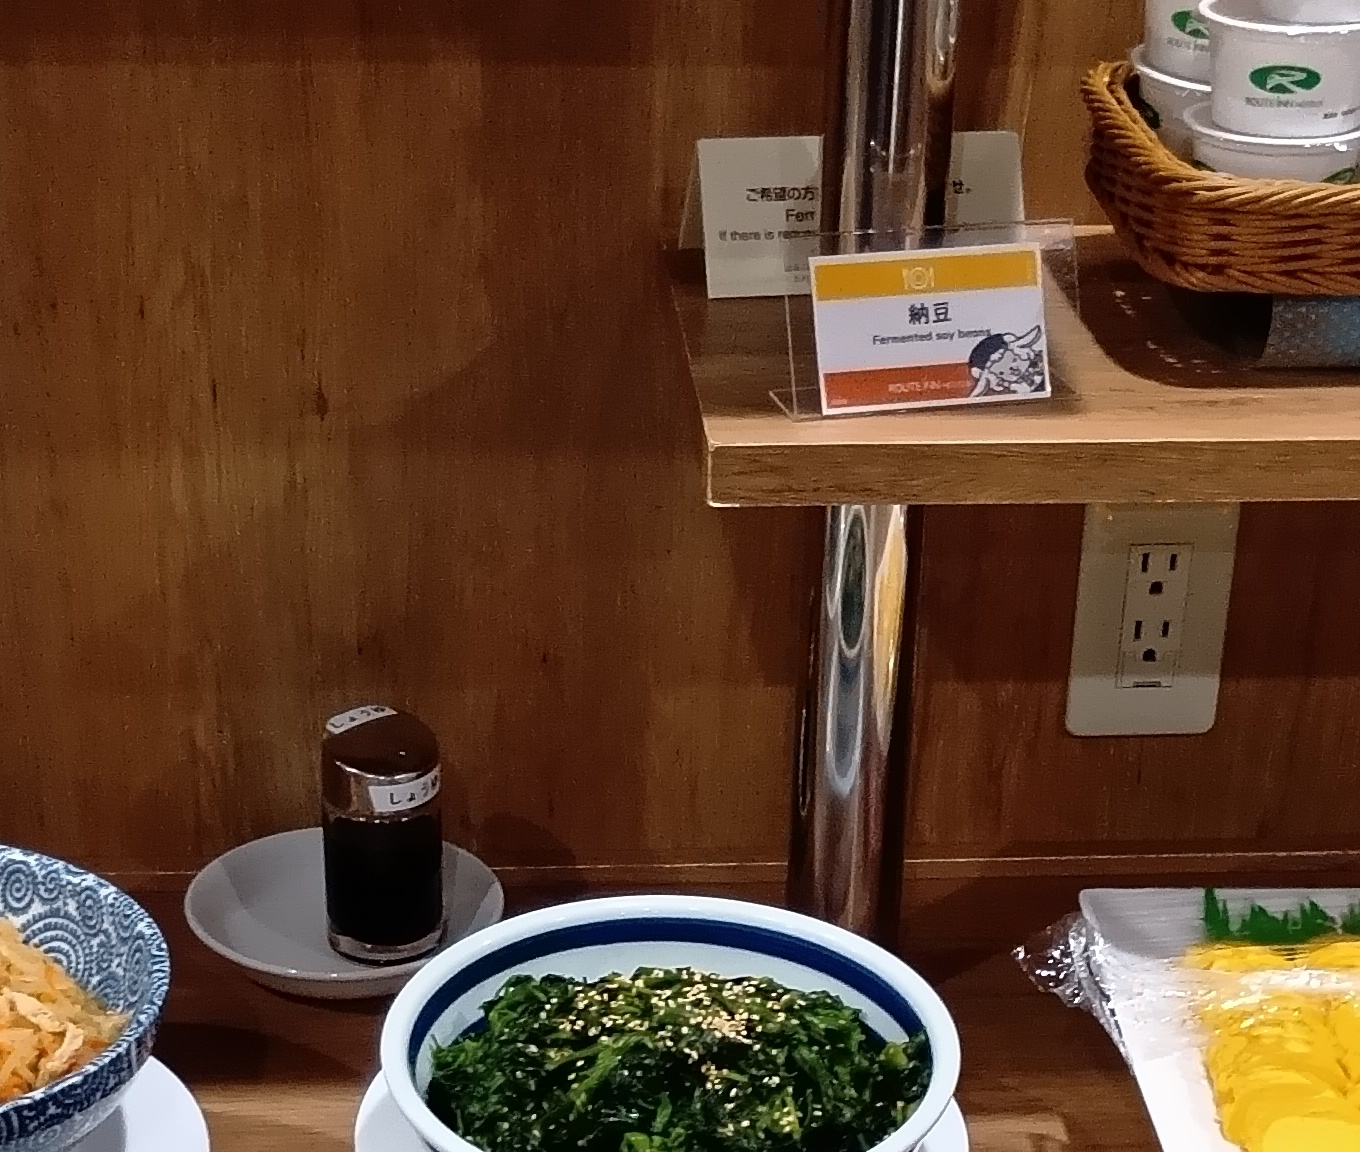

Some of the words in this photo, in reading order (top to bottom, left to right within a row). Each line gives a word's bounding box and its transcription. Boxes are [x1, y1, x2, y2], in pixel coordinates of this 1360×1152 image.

[908, 302, 953, 325] 納豆
[873, 332, 933, 345] Fermented
[935, 332, 955, 342] soy
